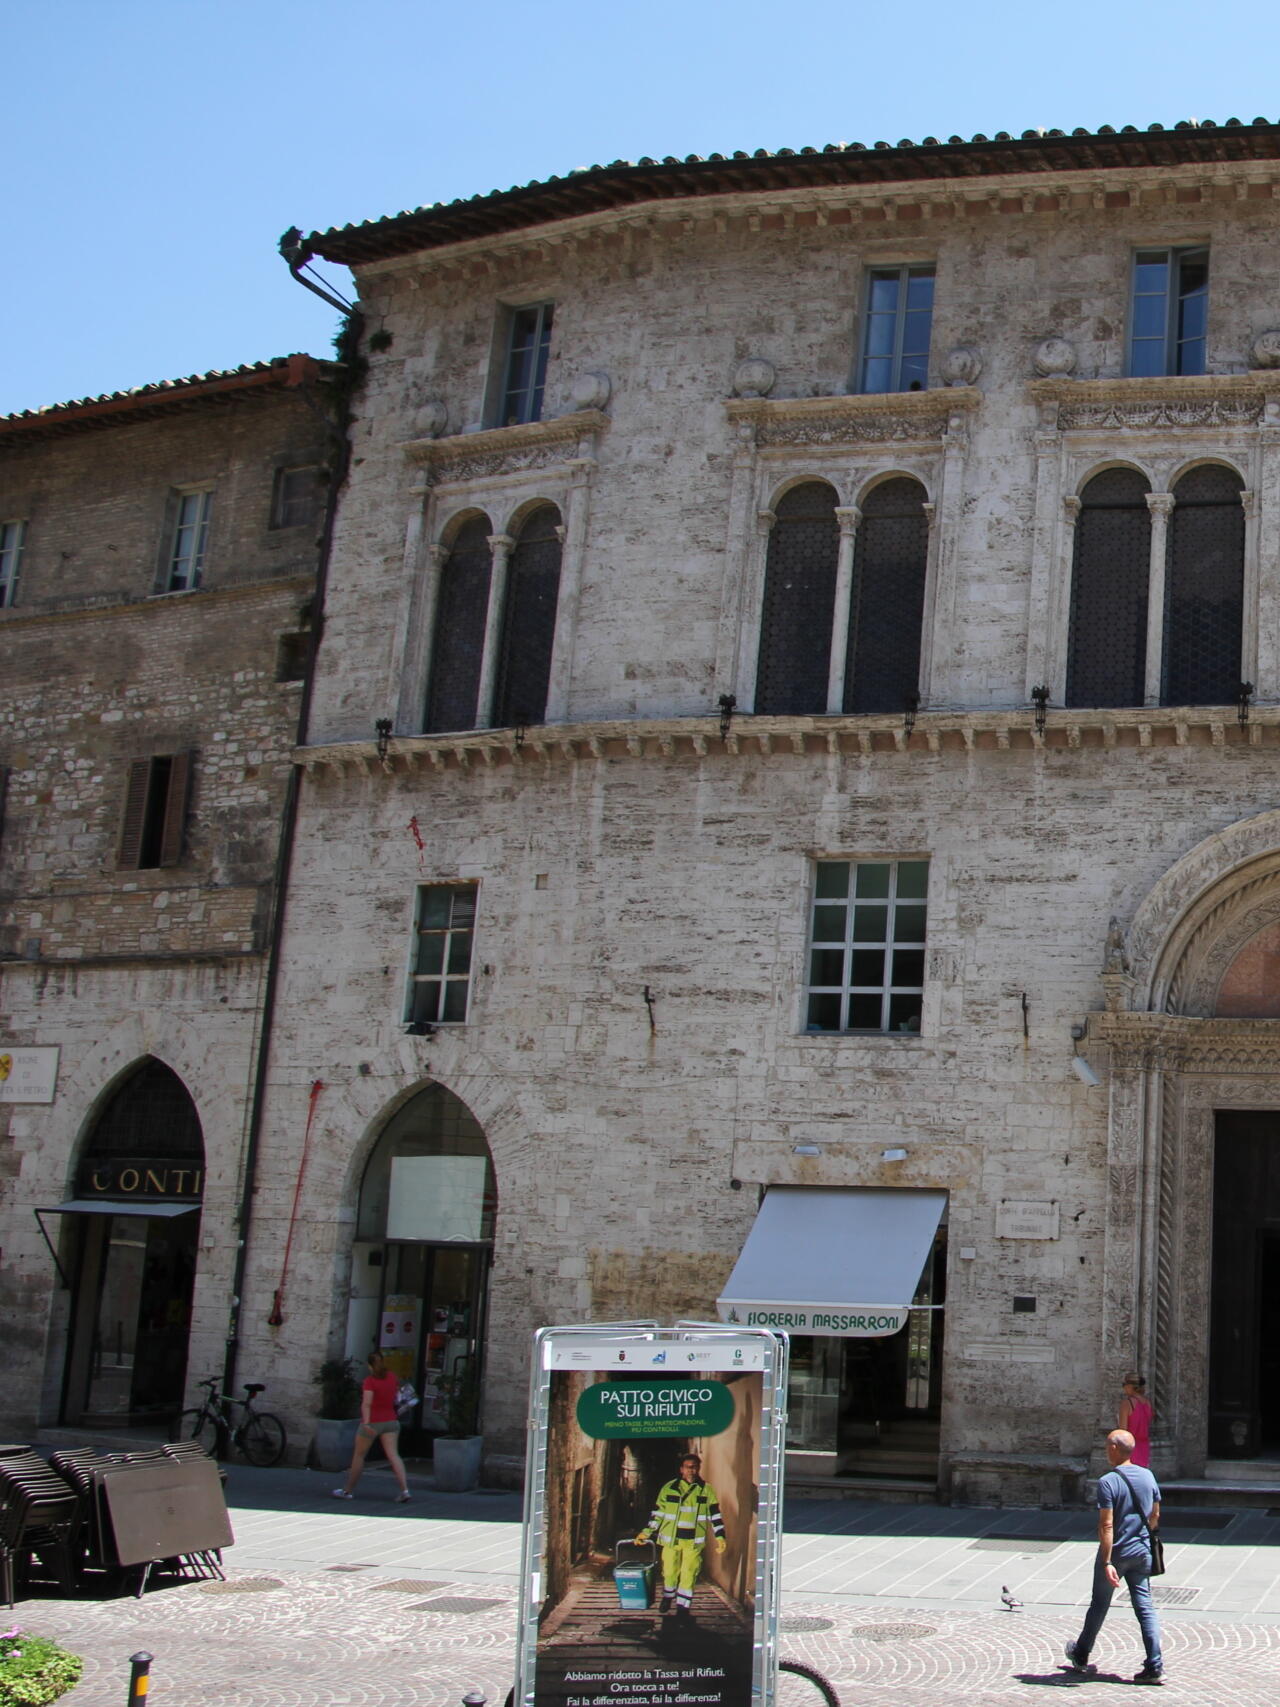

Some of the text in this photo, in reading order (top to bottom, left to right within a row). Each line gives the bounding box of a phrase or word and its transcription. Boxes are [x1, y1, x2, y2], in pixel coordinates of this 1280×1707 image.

[93, 1168, 200, 1192] CONTI
[747, 1312, 899, 1330] FIORERIA MASSARRONI
[601, 1389, 712, 1404] PATTO CIVICO
[617, 1403, 695, 1417] SUI RIFIUTI
[564, 1668, 726, 1681] Abbiamo ridotto la Tassa sui Rifiuti.
[610, 1682, 629, 1692] Ora
[632, 1684, 657, 1692] tocca
[667, 1681, 679, 1691] te!
[567, 1692, 721, 1706] Fai la differenziata, fai la differenza!
